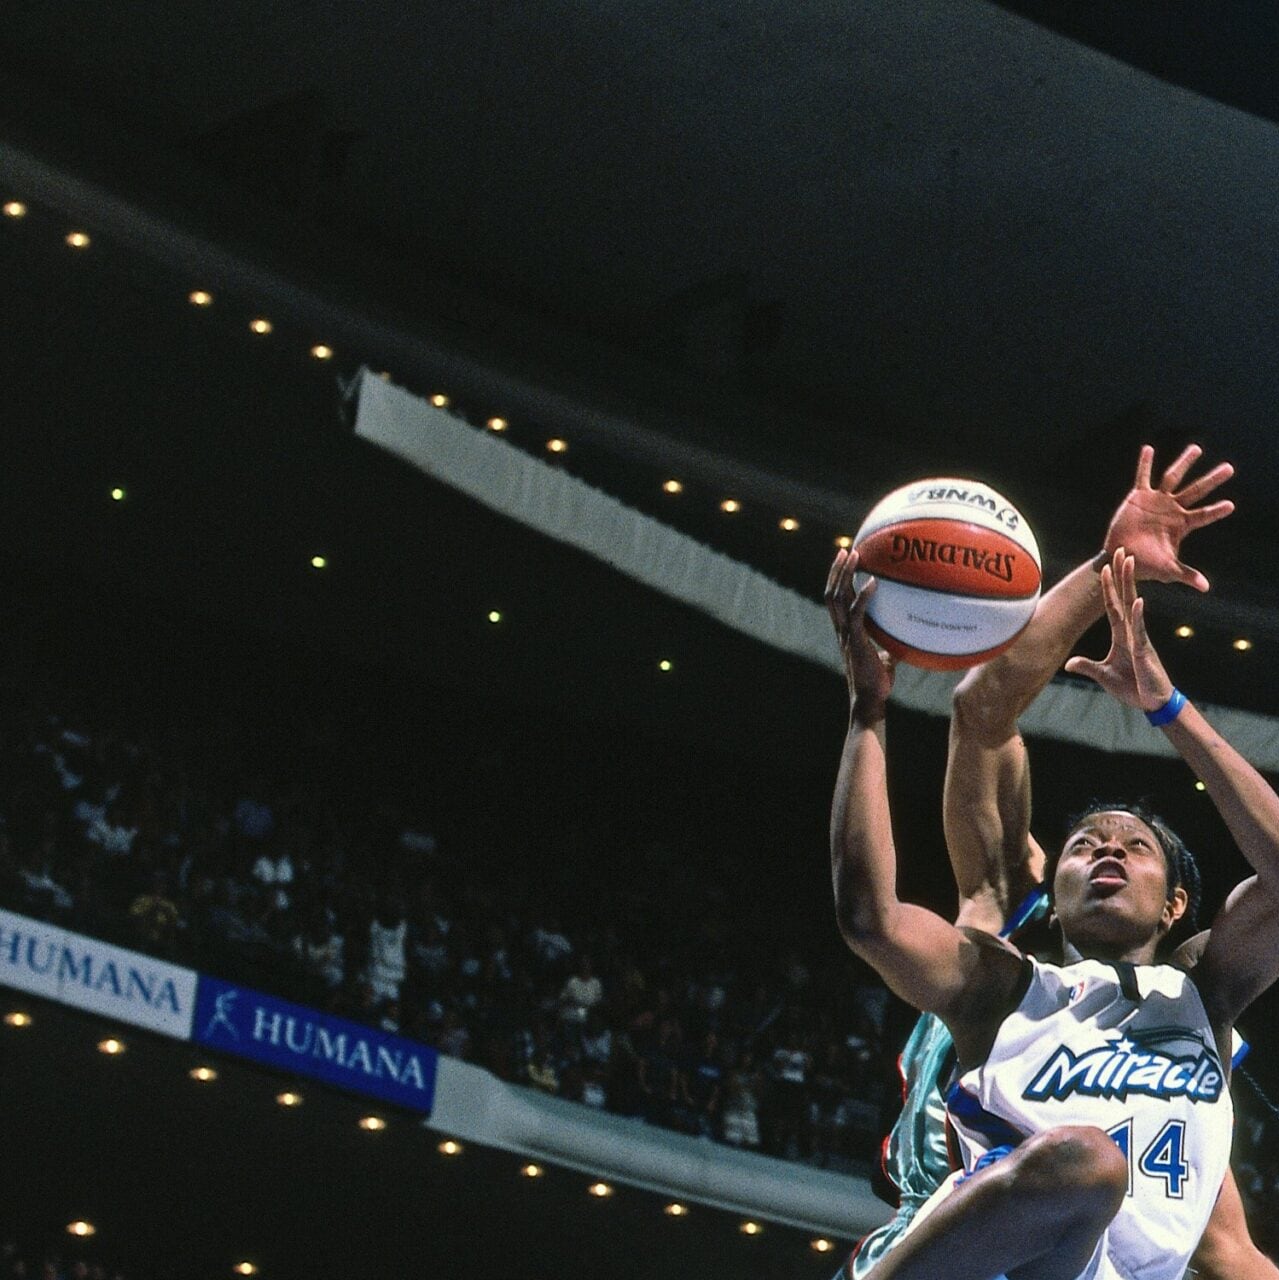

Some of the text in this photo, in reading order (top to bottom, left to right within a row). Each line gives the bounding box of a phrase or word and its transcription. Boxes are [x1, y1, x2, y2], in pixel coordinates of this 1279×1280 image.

[891, 535, 1015, 582] SPALDING
[0, 928, 181, 1014] HUMANA
[251, 1006, 425, 1090] HUMANA
[1021, 1037, 1224, 1104] Miracle
